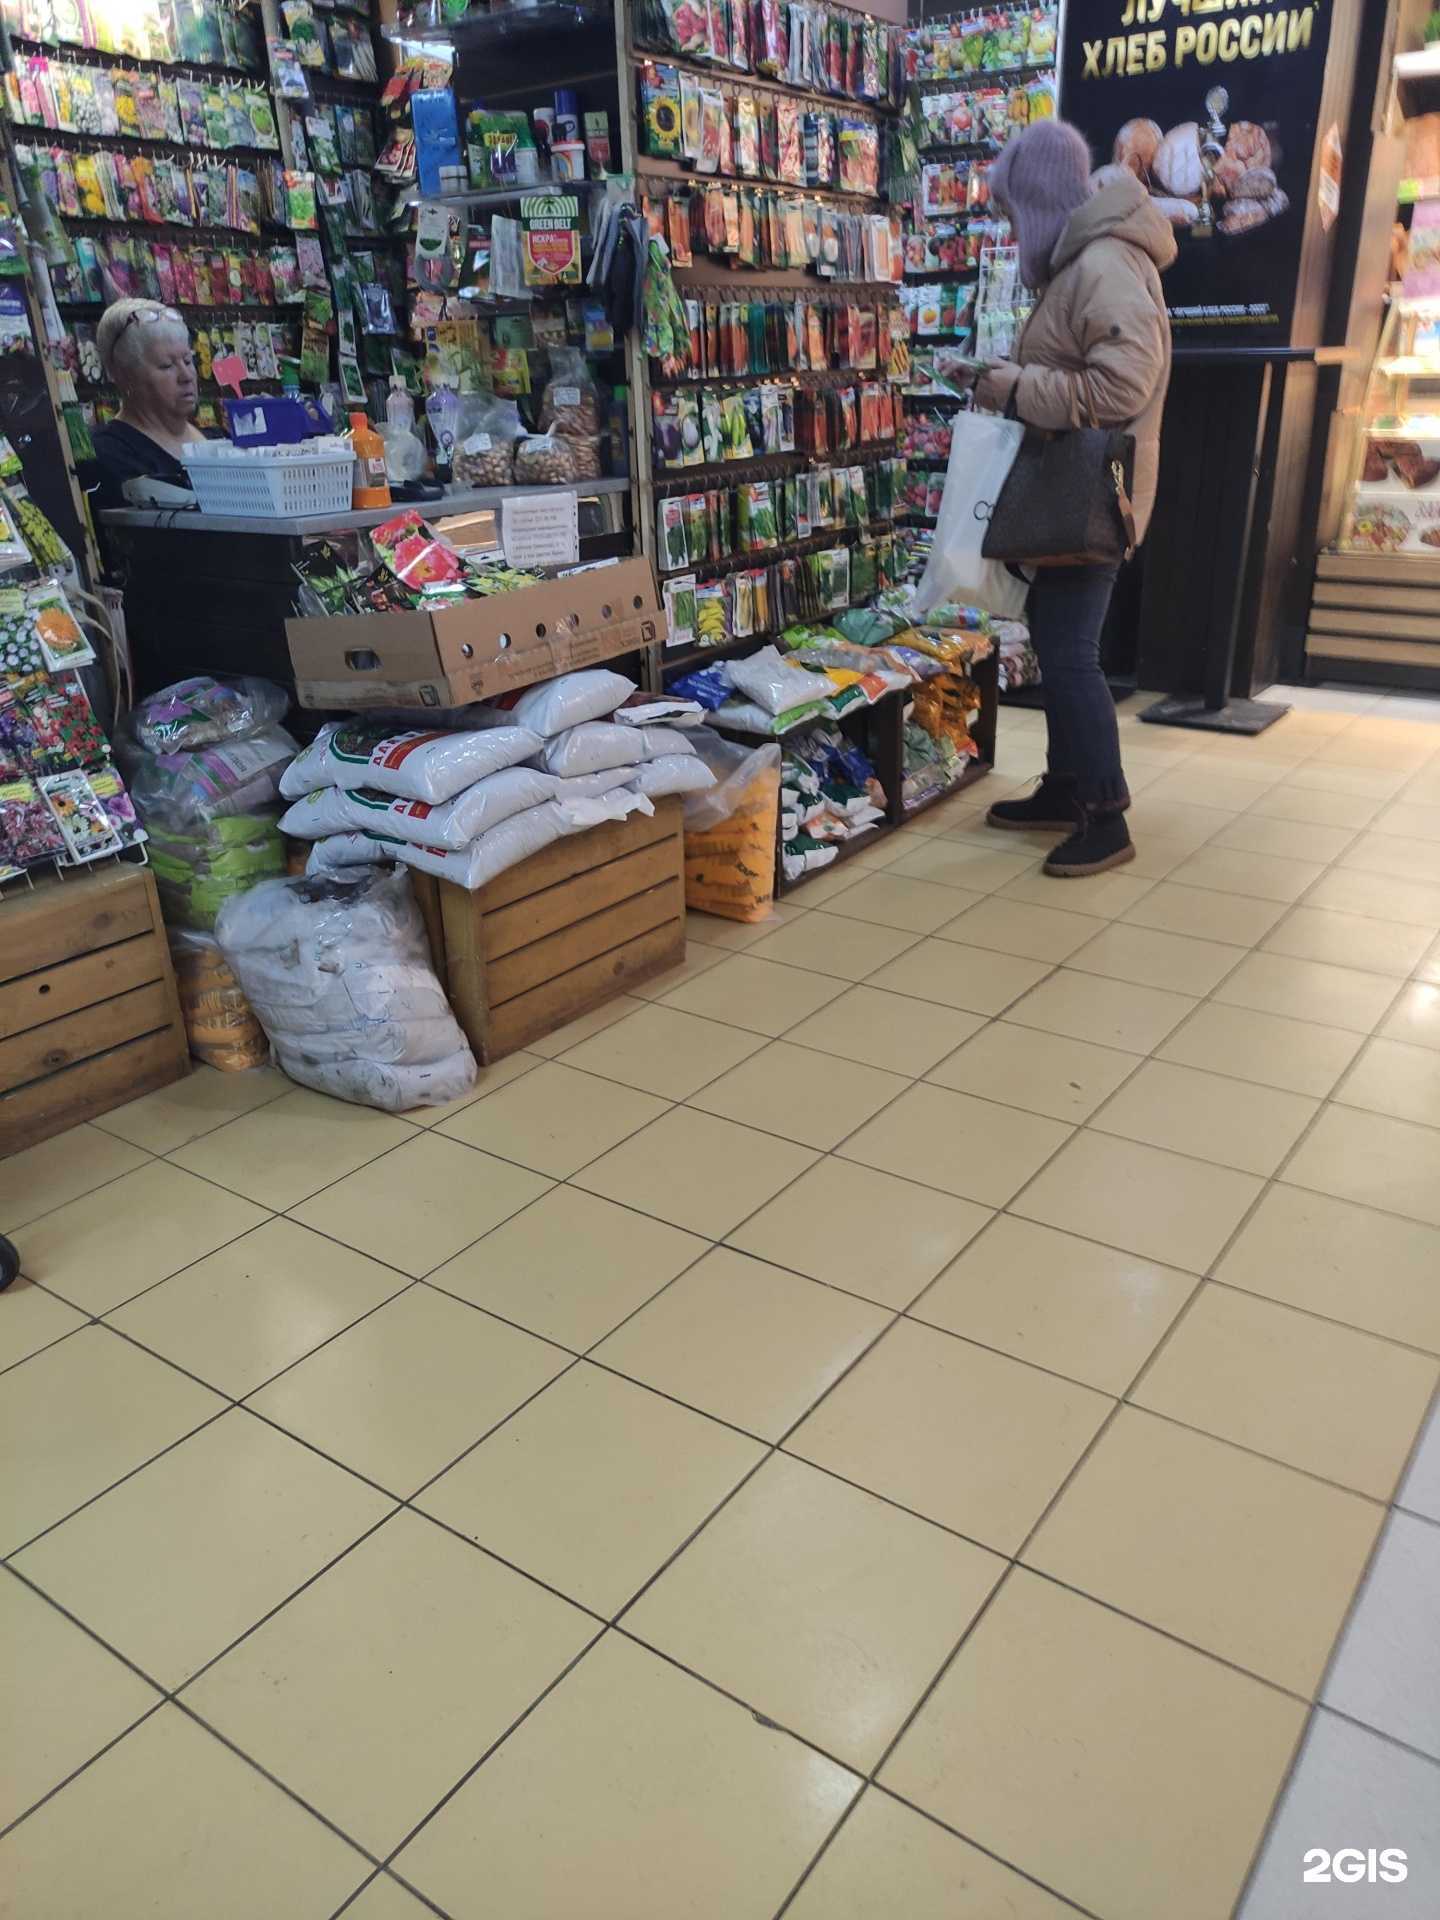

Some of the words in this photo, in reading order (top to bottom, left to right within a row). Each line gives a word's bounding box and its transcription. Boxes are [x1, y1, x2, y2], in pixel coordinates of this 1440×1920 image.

[1081, 30, 1167, 80] ХЛЕБ
[1174, 7, 1314, 69] РОССИИ
[529, 218, 553, 230] GREEN
